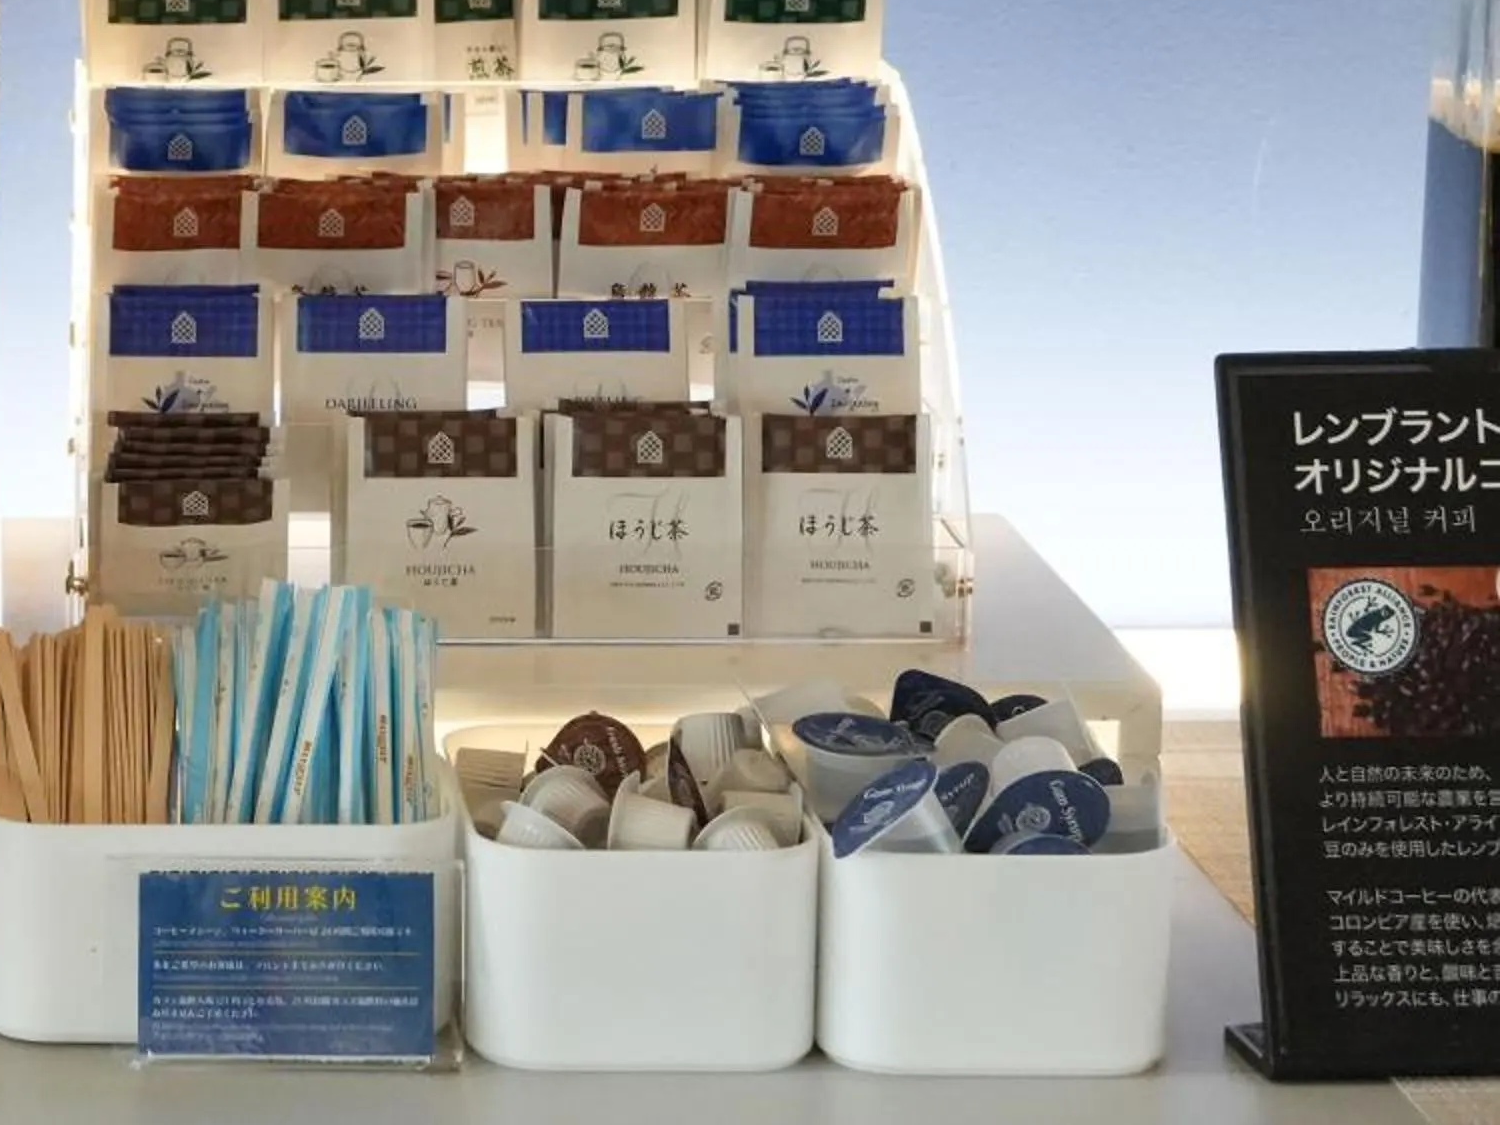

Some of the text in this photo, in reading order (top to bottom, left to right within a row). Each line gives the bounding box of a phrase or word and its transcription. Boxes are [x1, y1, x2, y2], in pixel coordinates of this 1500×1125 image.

[1293, 407, 1500, 446] レンブラント
[609, 519, 689, 541] ほうじ茶
[799, 514, 879, 536] ほうじ茶
[1300, 505, 1477, 535] 오리지널 커피
[406, 564, 476, 575] HOUJICHA
[619, 564, 679, 574] HOUJICHA
[810, 559, 870, 570] HOUJICHA
[1319, 765, 1492, 784] 人と自然の未来のため、
[219, 884, 357, 911] ご利用案内
